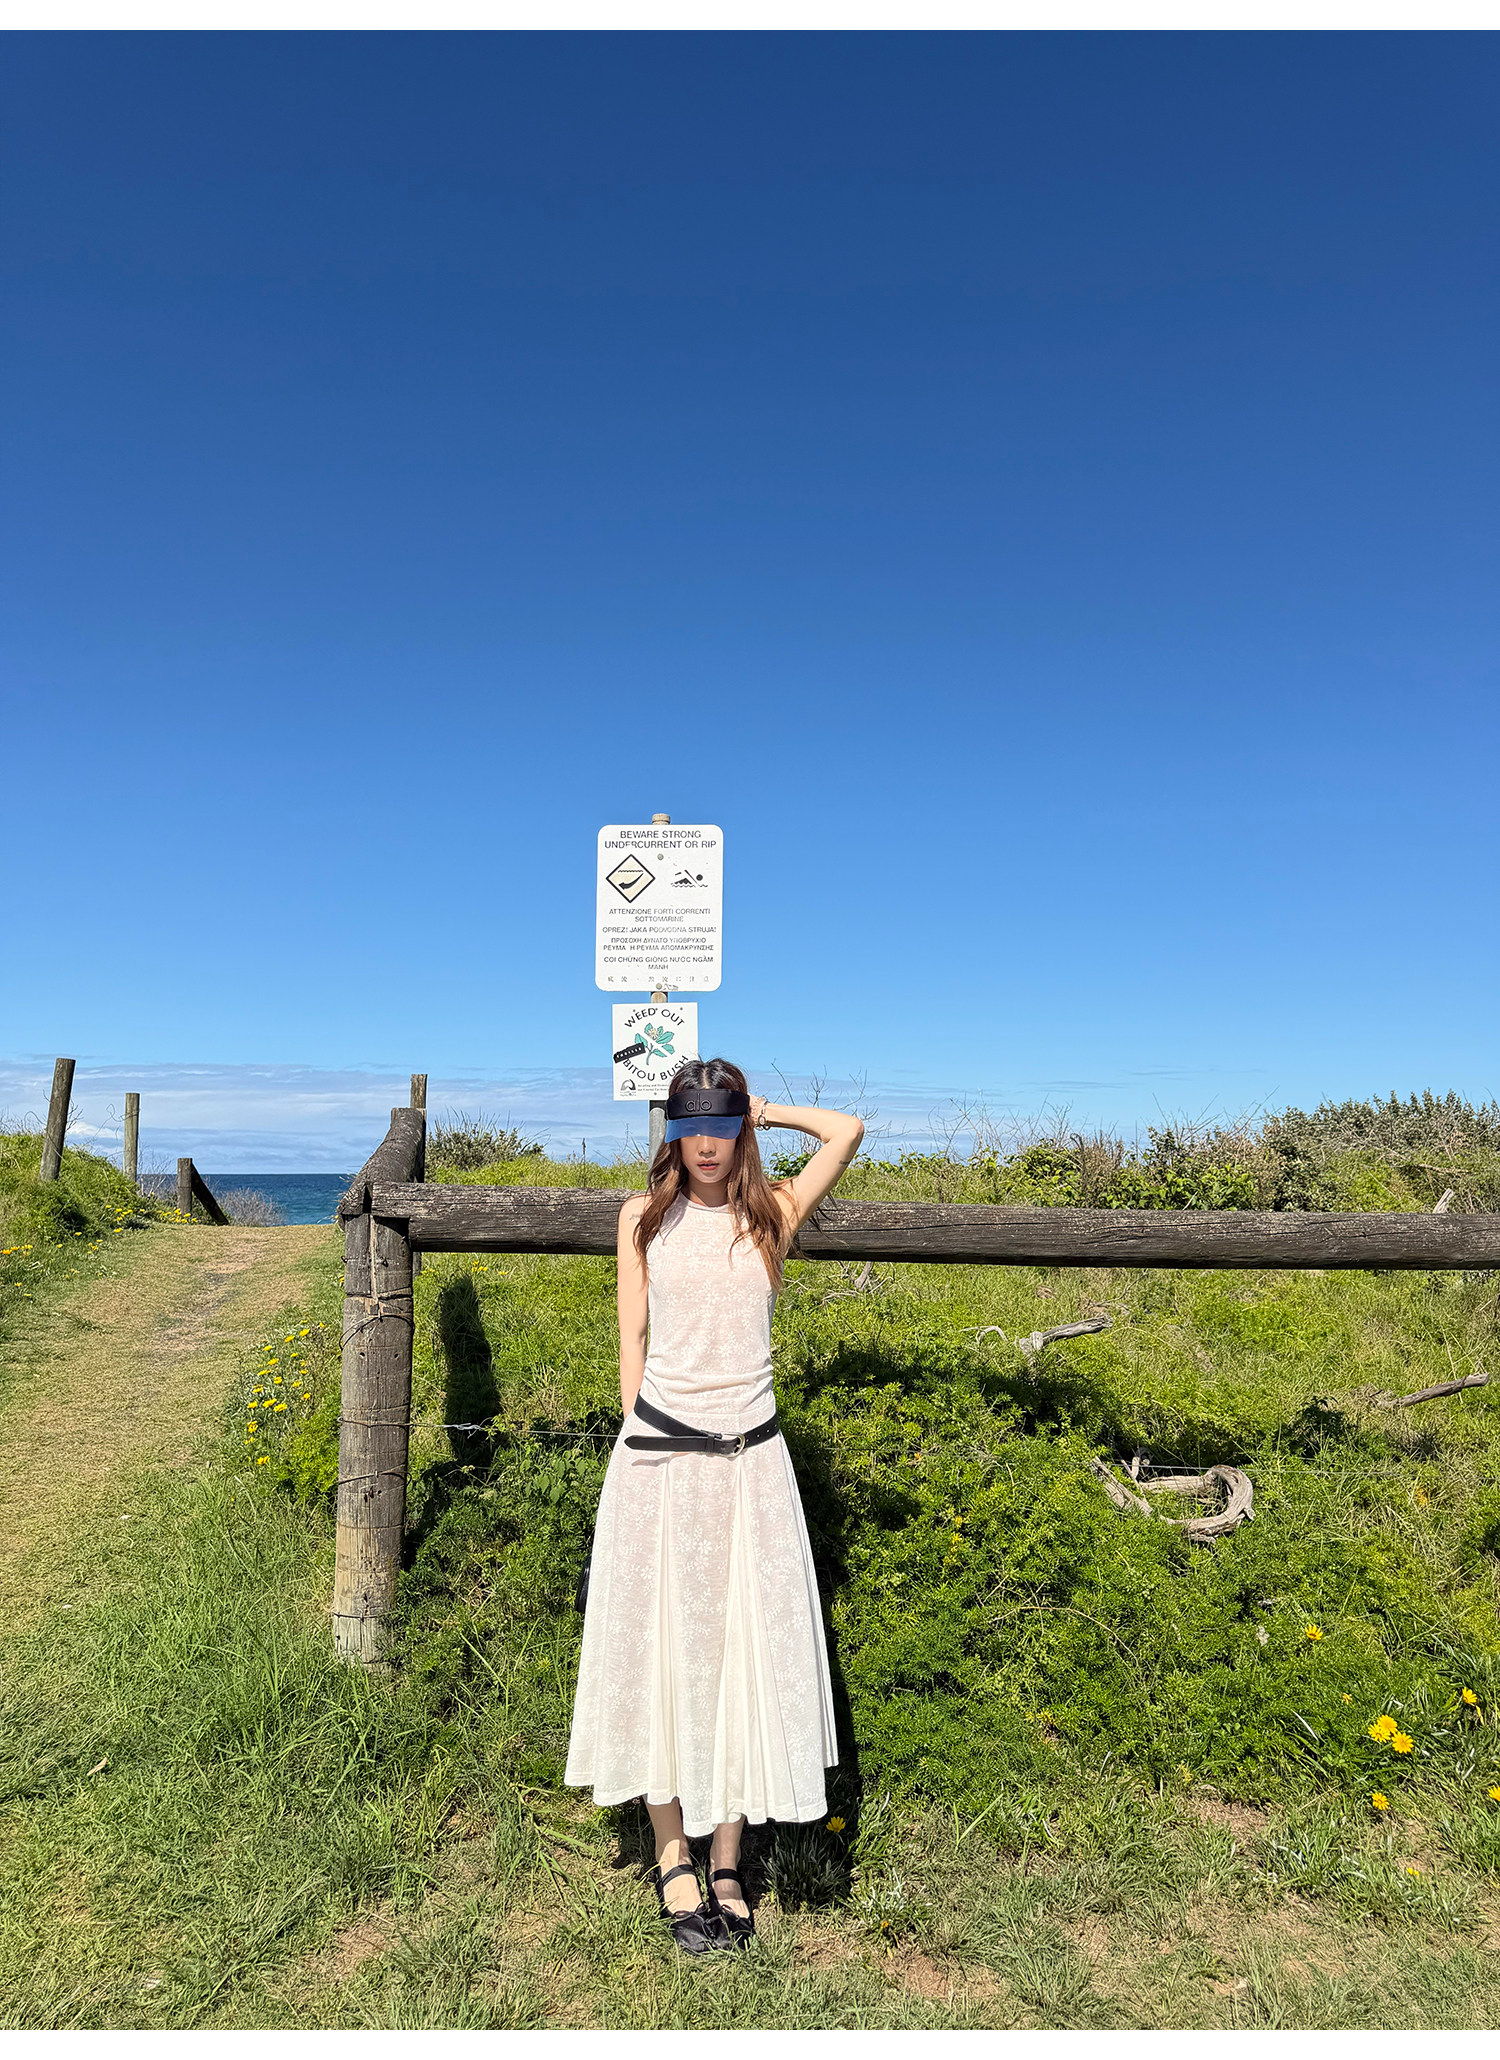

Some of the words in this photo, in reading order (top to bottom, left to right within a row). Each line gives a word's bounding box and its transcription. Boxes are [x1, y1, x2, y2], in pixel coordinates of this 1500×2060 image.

[684, 840, 699, 848] OR
[701, 840, 717, 848] RIP
[624, 1007, 656, 1028] WEED
[661, 1009, 685, 1026] OUT
[622, 1058, 656, 1081] BITOU
[660, 1055, 689, 1080] BUSH
[685, 1093, 713, 1112] alo
